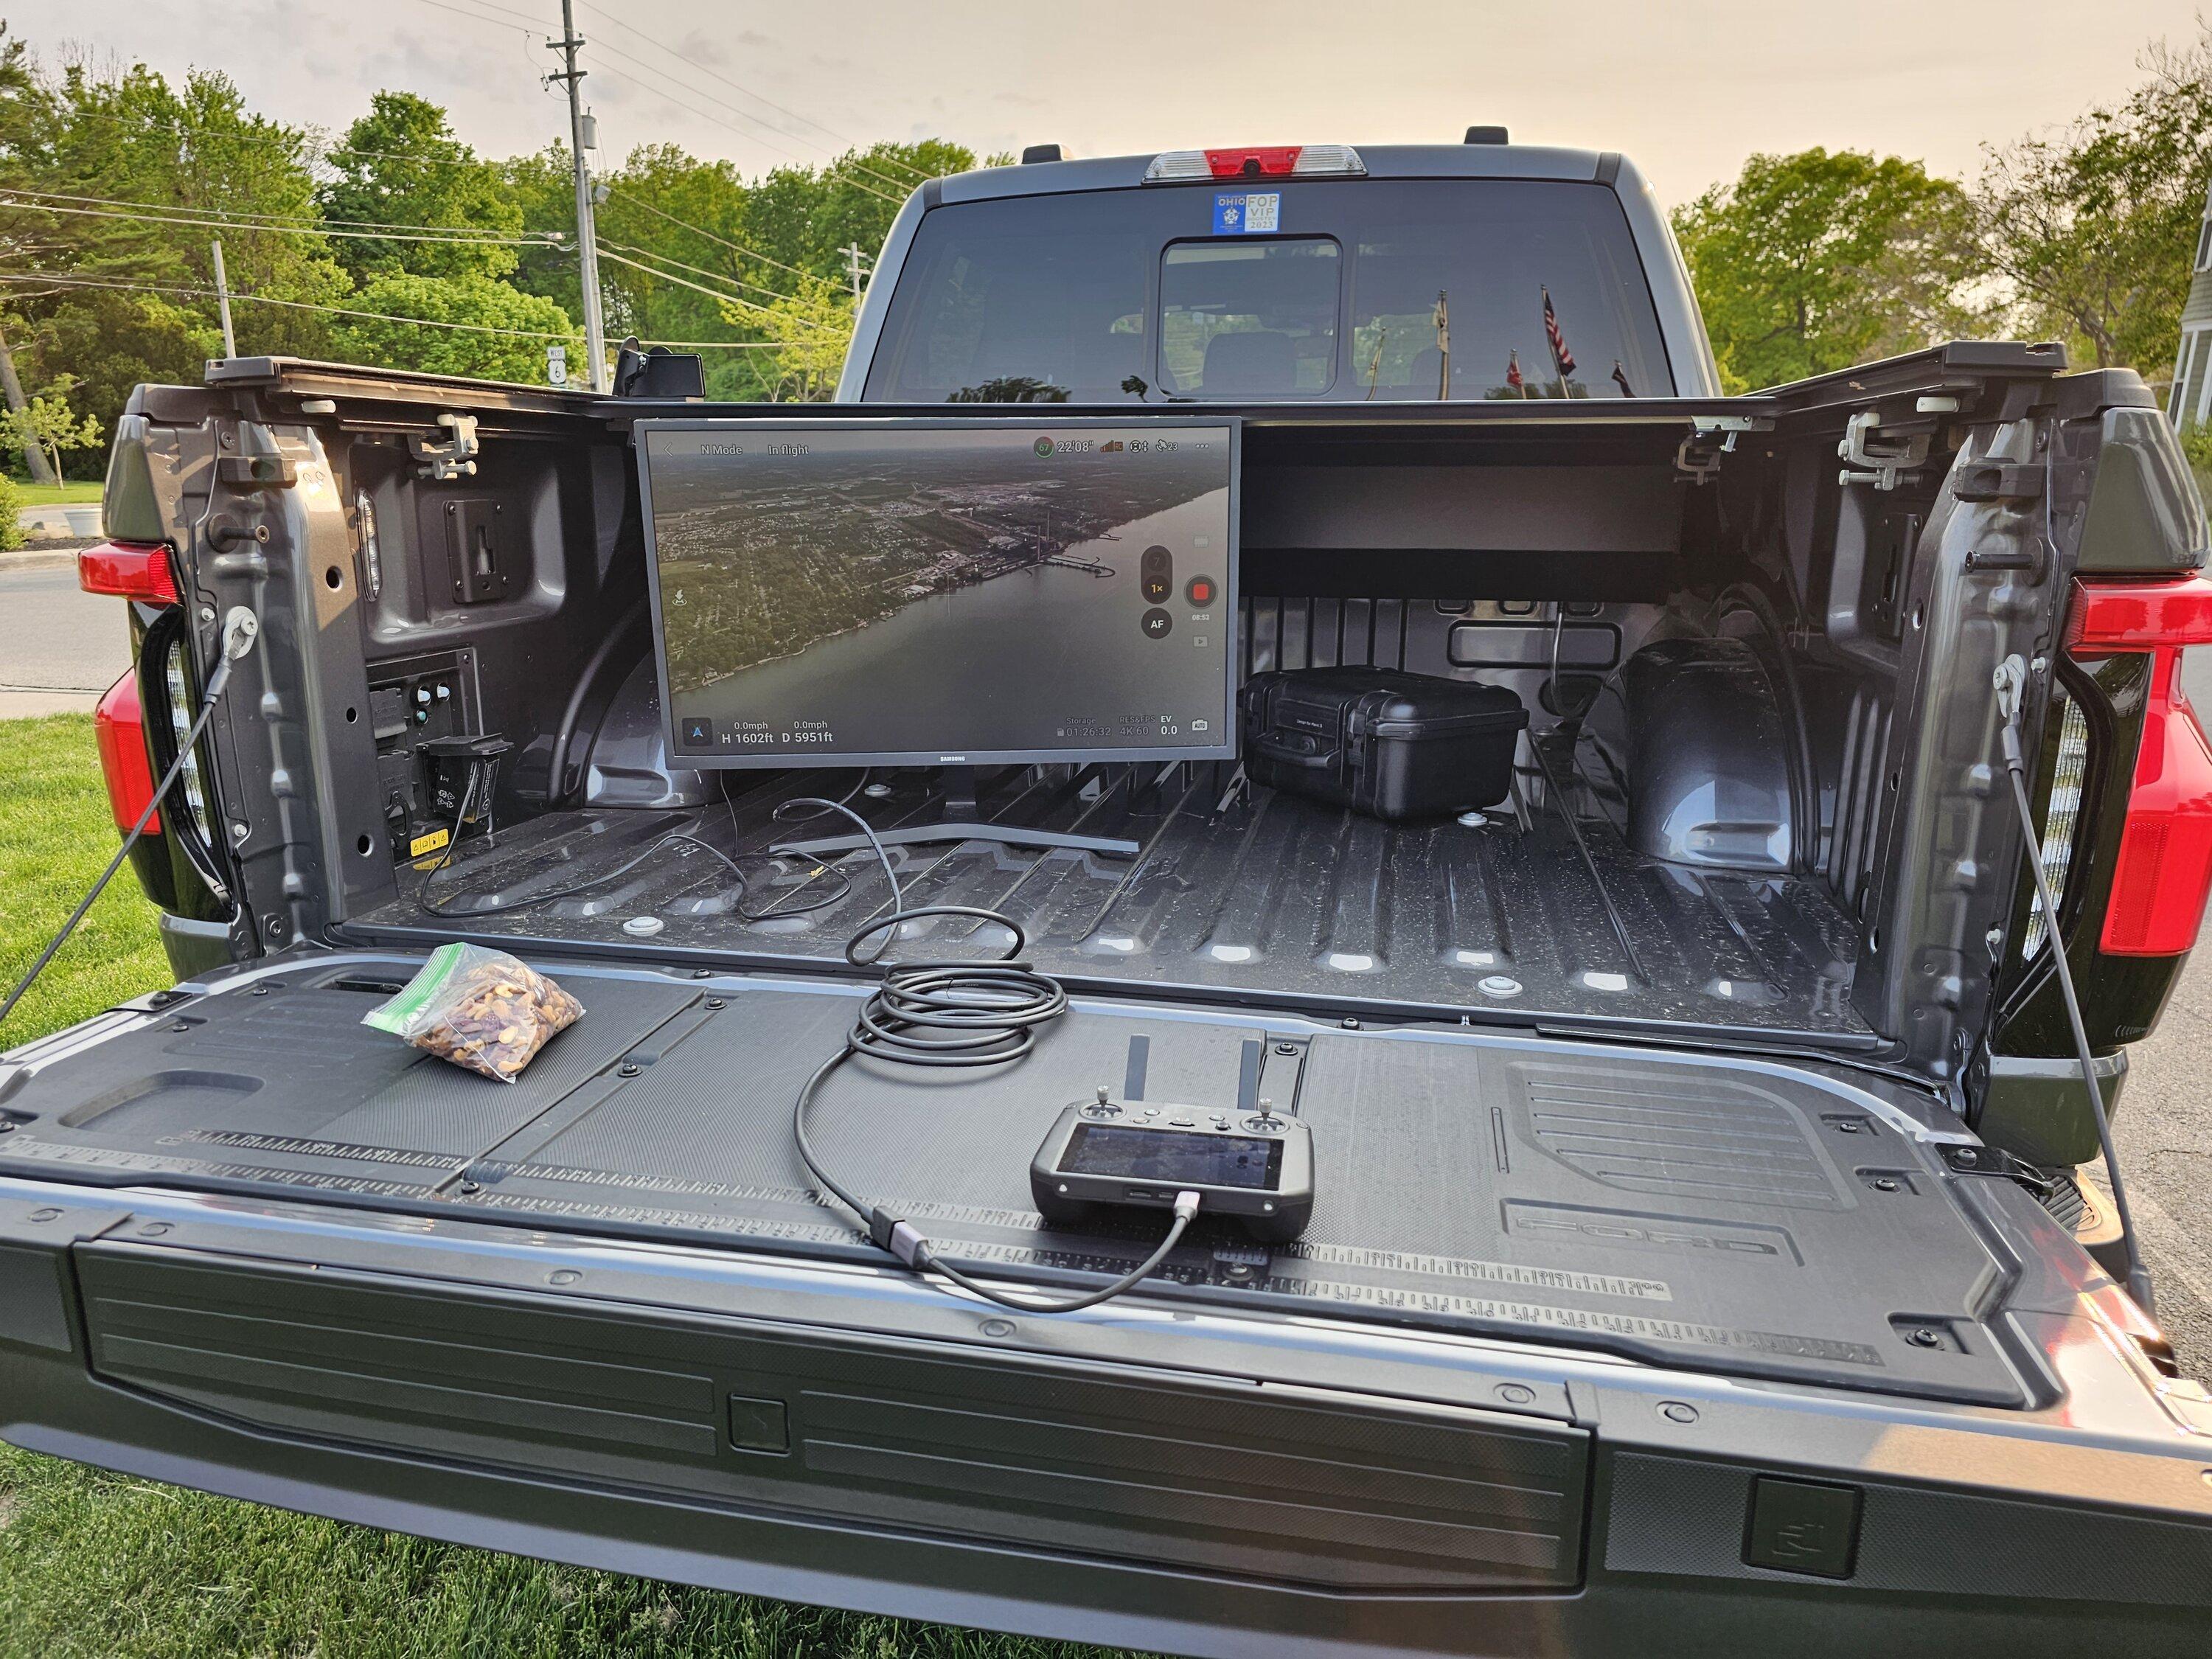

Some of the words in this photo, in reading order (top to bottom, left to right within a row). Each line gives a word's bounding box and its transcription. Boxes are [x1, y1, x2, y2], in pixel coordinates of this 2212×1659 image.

[1218, 198, 1245, 206] OHIO
[1247, 195, 1278, 207] FOP
[1251, 208, 1274, 216] VIP
[554, 366, 561, 378] 6
[701, 445, 711, 456] N
[712, 445, 743, 456] Mode
[768, 445, 779, 456] In
[781, 445, 809, 457] flight
[1167, 443, 1178, 451] 23
[1150, 619, 1164, 629] AF
[1066, 717, 1096, 726] Storage
[1119, 715, 1156, 724] RES&FPS
[1161, 715, 1172, 723] EV
[734, 721, 768, 731] 0.0mph
[793, 720, 828, 731] 0.0mph
[1161, 725, 1178, 735] 0.0
[1066, 727, 1112, 737] 01:26:32
[1119, 726, 1133, 736] 4K
[1135, 726, 1150, 736] 60
[722, 734, 731, 744] H
[736, 733, 773, 744] 1602ft
[782, 733, 790, 743] D
[795, 732, 833, 742] 5951ft
[1516, 1217, 1779, 1255] FORD
